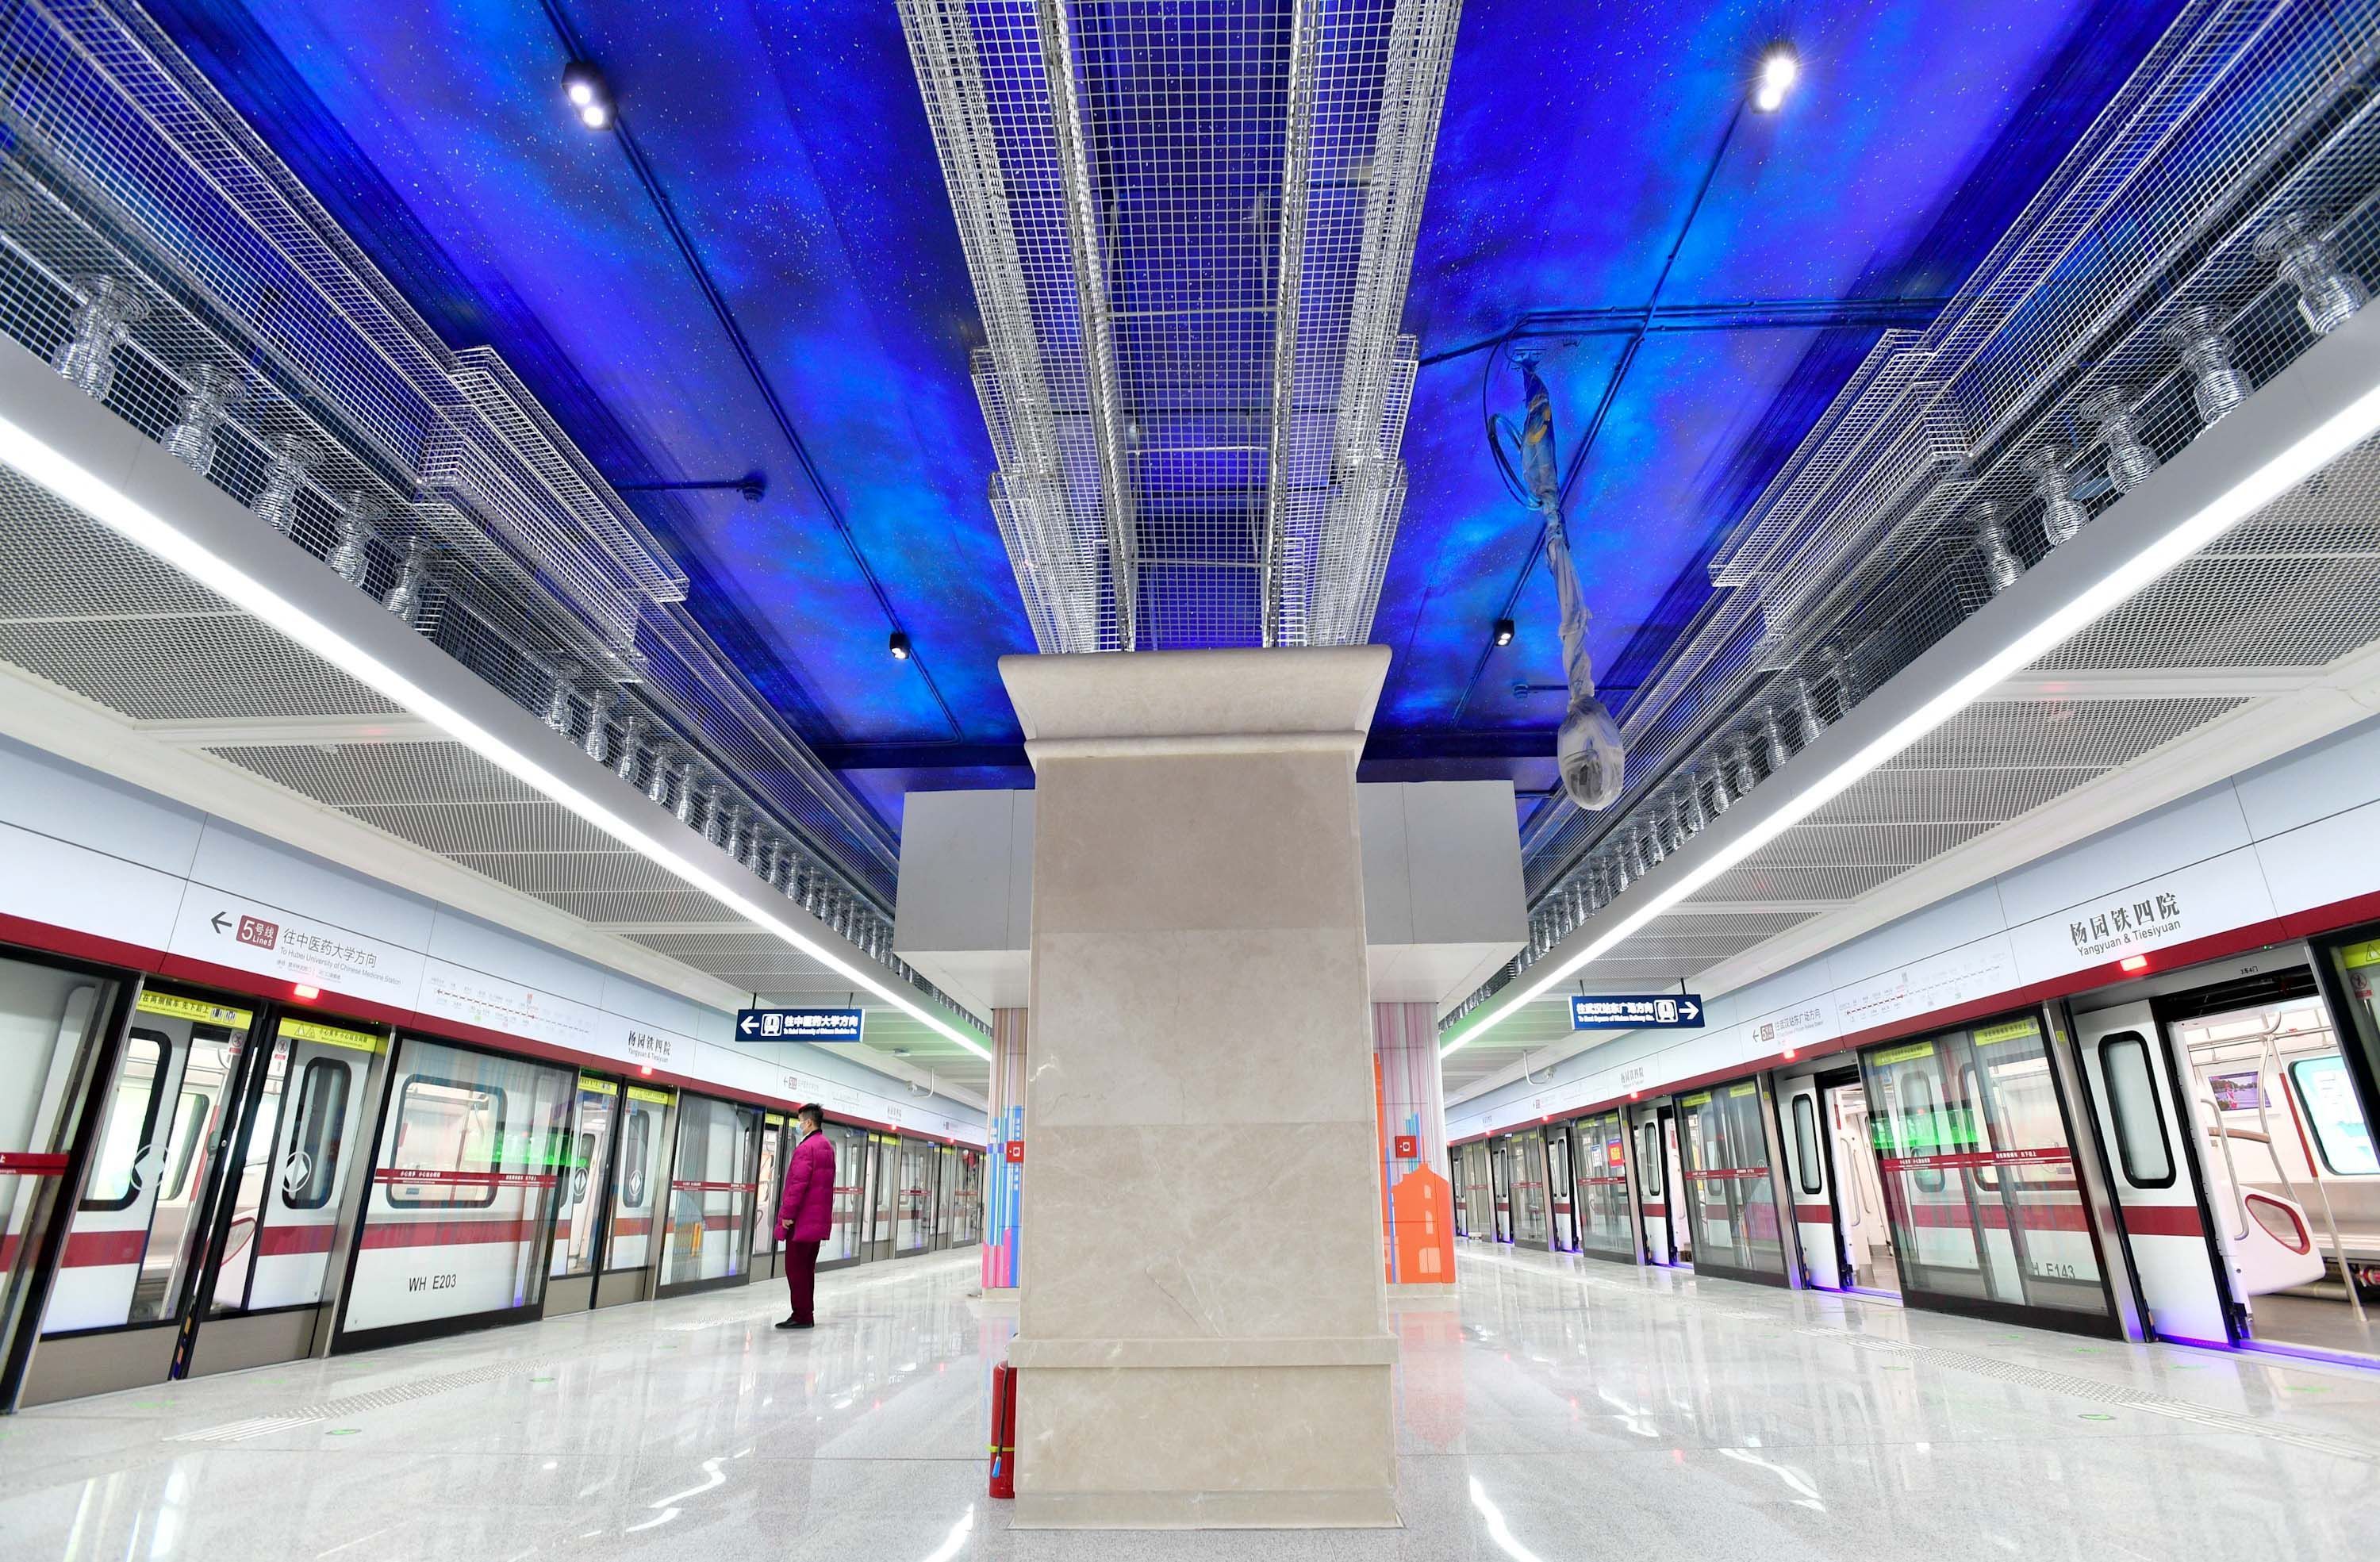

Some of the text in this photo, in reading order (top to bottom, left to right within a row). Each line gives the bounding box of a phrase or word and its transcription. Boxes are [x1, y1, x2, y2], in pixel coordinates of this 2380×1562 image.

[2070, 892, 2180, 946] 杨园铁四院
[283, 928, 378, 969] 往中医药大学方向
[2077, 920, 2181, 957] Yangyuan & Tiesiyuan
[628, 1030, 671, 1056] 杨园铁四院
[409, 1273, 457, 1292] WH E203
